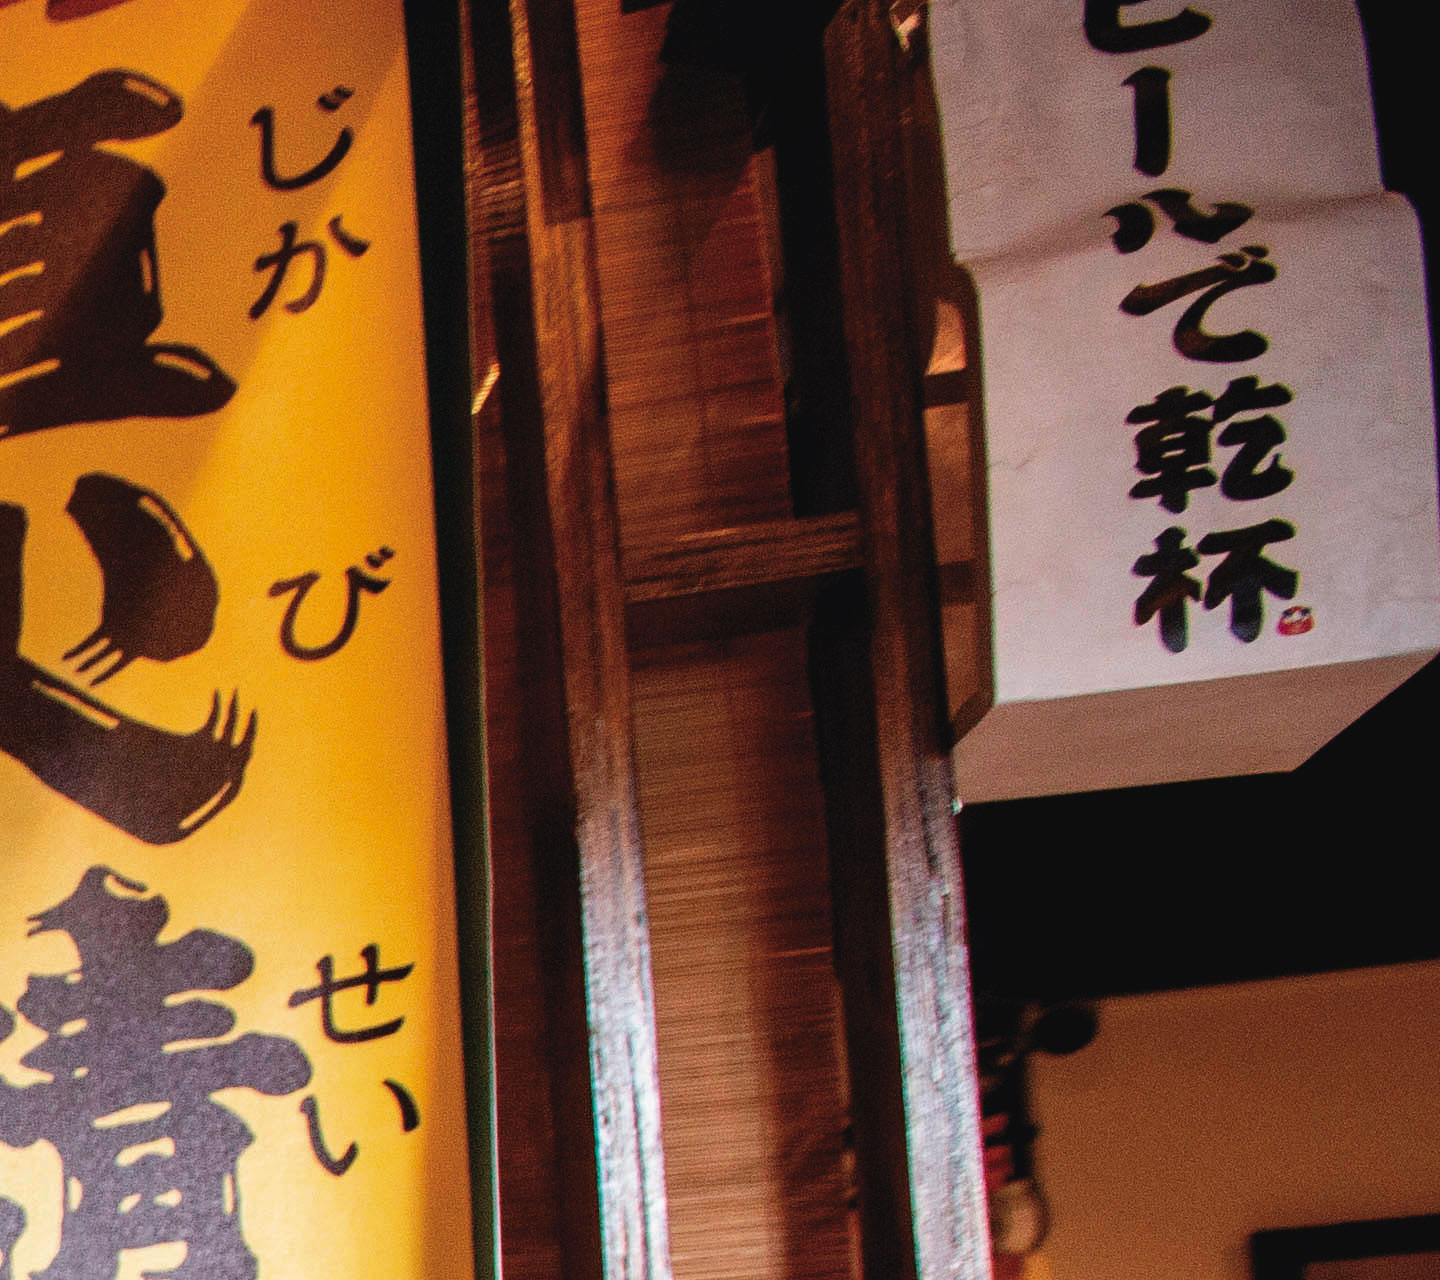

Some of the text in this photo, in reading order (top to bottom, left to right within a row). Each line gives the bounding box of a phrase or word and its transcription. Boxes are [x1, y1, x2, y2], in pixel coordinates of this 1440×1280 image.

[248, 84, 370, 319] じか
[269, 546, 394, 661] び
[288, 943, 419, 1177] せい
